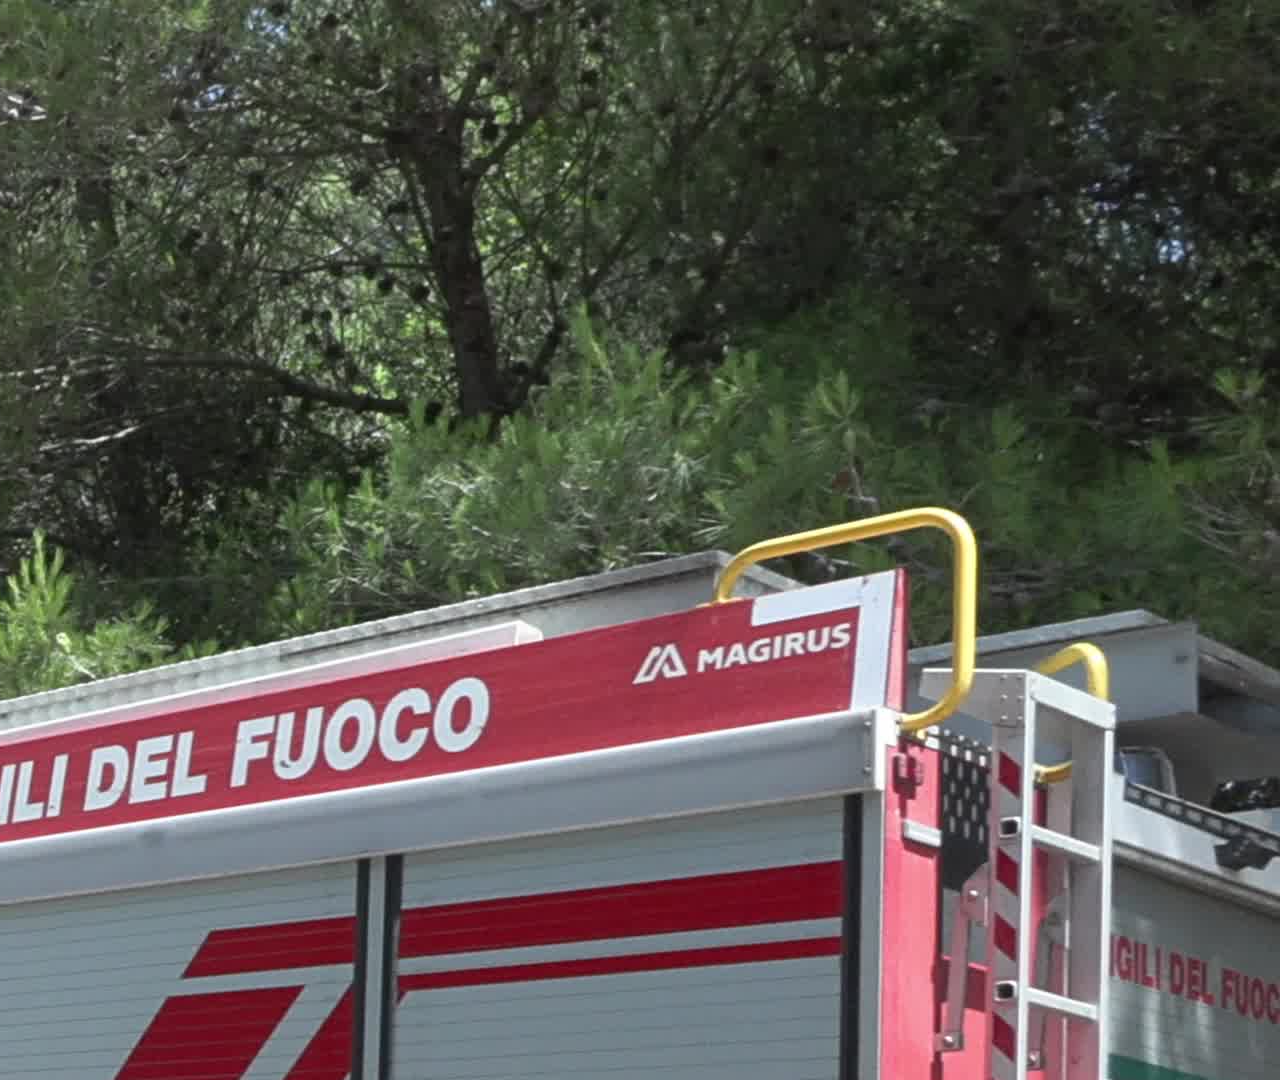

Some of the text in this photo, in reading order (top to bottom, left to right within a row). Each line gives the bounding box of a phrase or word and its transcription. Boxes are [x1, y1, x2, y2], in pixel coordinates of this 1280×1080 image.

[697, 623, 851, 673] MAGIRUS
[83, 731, 207, 812] DEL
[230, 677, 490, 788] FUOCO
[1110, 936, 1280, 1024] IGILI DEL FUOC
